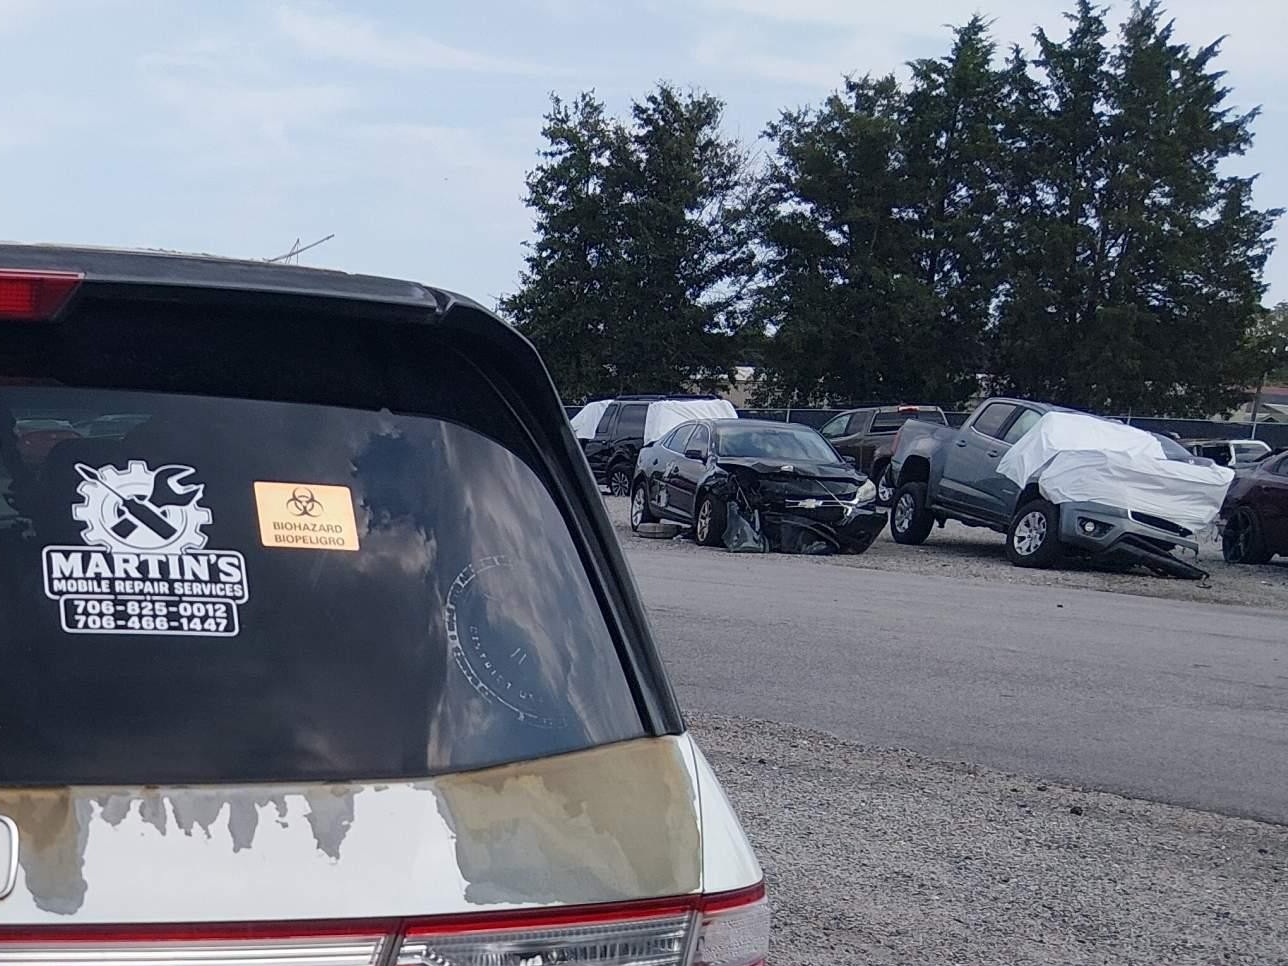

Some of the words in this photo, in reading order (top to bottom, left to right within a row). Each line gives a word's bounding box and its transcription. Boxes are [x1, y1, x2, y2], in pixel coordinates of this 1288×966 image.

[272, 521, 343, 534] BIOHAZARD
[274, 534, 345, 547] BIOPELIGRO
[51, 552, 242, 583] MARTIN'S
[53, 579, 111, 593] MOBILE
[115, 581, 170, 595] REPAIR
[174, 582, 243, 597] SERVICES
[73, 600, 227, 617] 706-825-0012
[74, 615, 228, 632] 706-466-1447
